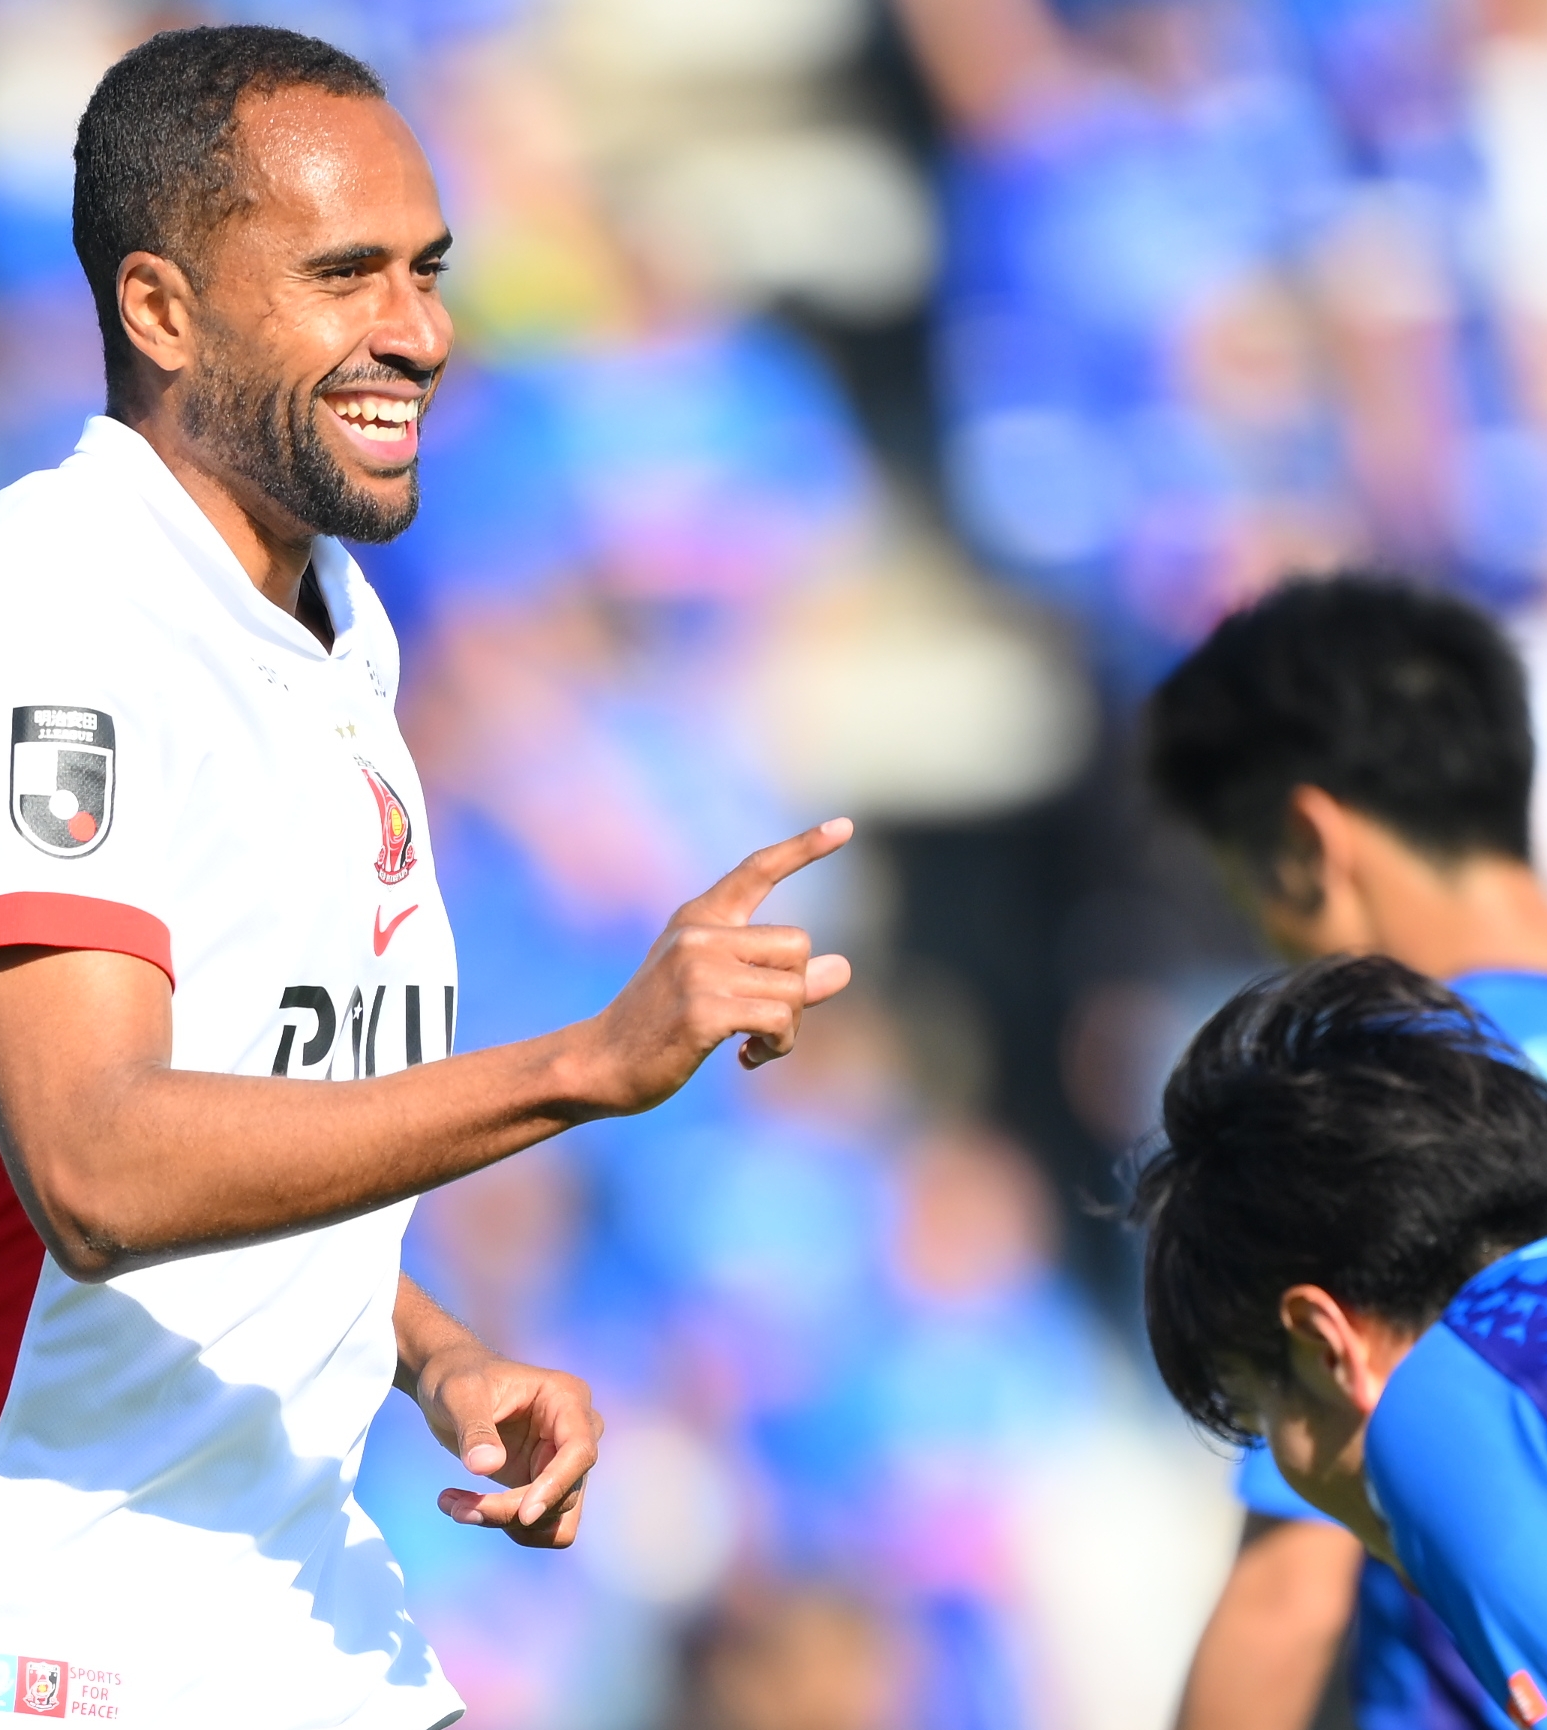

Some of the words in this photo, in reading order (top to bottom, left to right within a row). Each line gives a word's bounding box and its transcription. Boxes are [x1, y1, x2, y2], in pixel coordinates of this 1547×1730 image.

[69, 1666, 122, 1686] SPORTS
[82, 1685, 109, 1701] FOR
[71, 1701, 119, 1720] PEACE!
